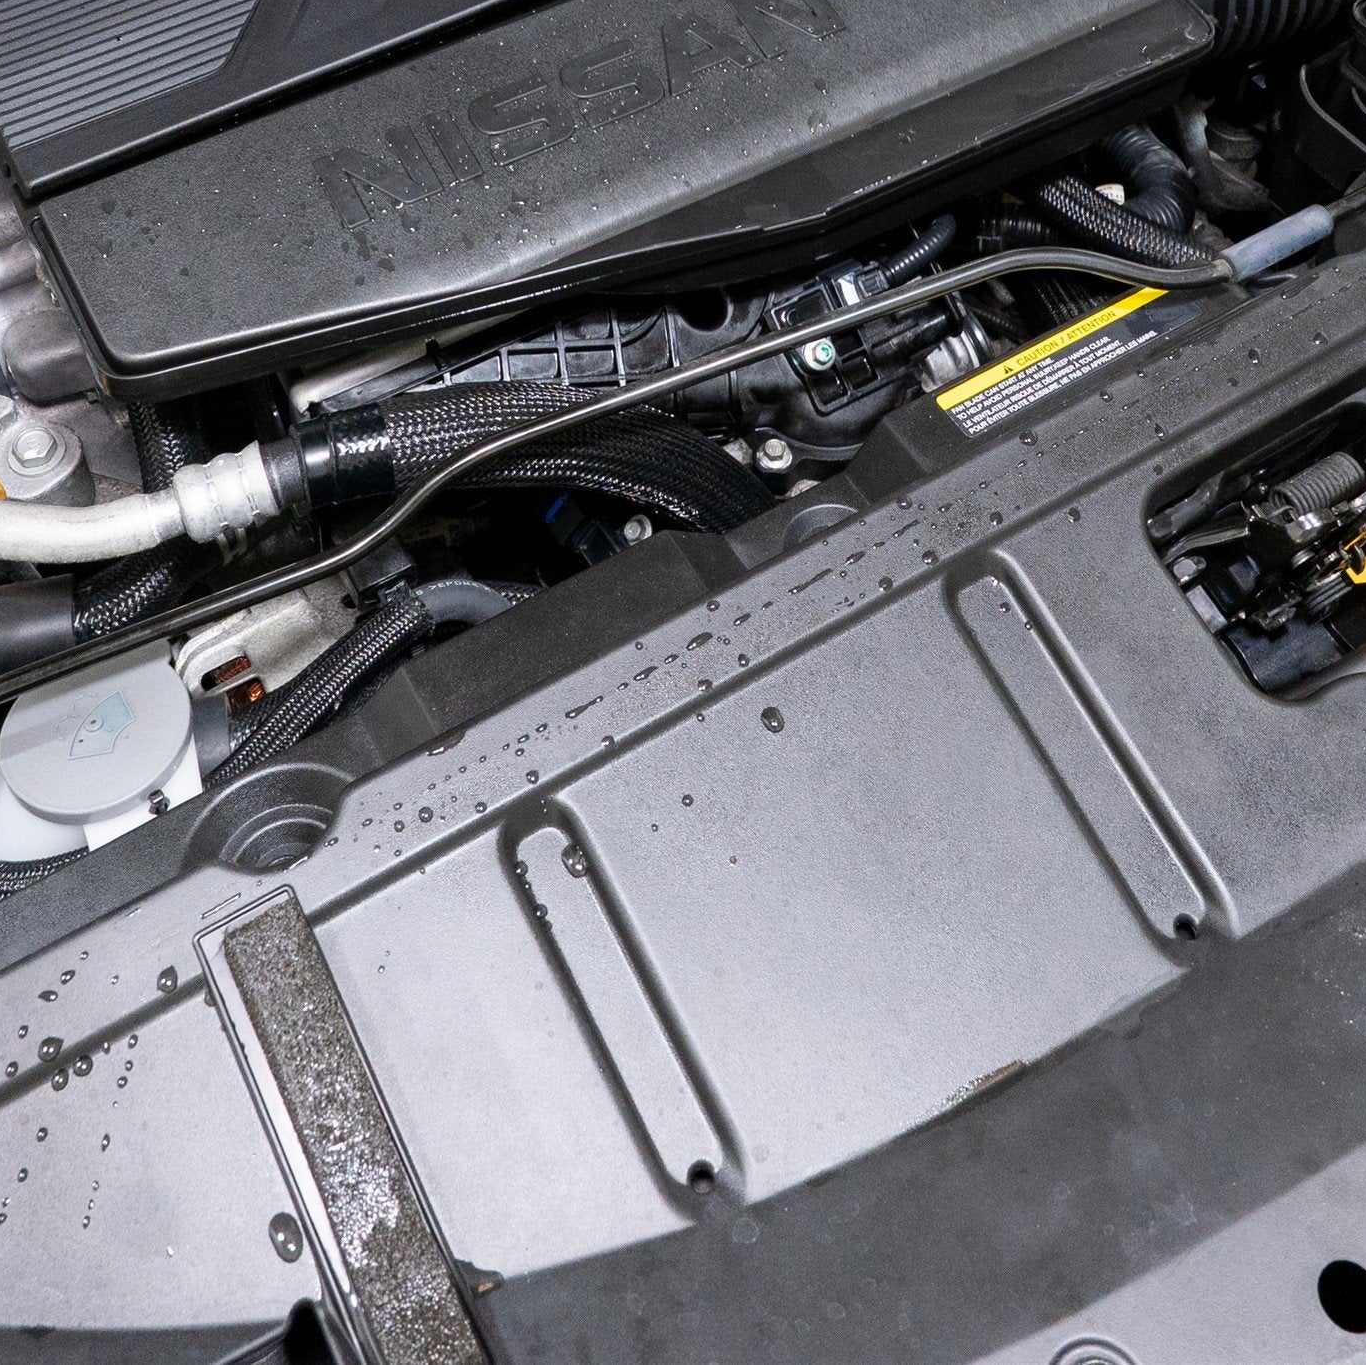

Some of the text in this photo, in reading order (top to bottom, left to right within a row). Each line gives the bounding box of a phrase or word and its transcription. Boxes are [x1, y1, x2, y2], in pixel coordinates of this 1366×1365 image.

[1017, 340, 1059, 366] CAUTION
[1067, 310, 1117, 340] ATTENTION
[950, 403, 966, 414] FAN
[984, 385, 999, 396] CAN
[998, 375, 1018, 389] START
[956, 412, 967, 421] TO
[966, 403, 983, 415] HELP
[982, 393, 1002, 406] AVOID
